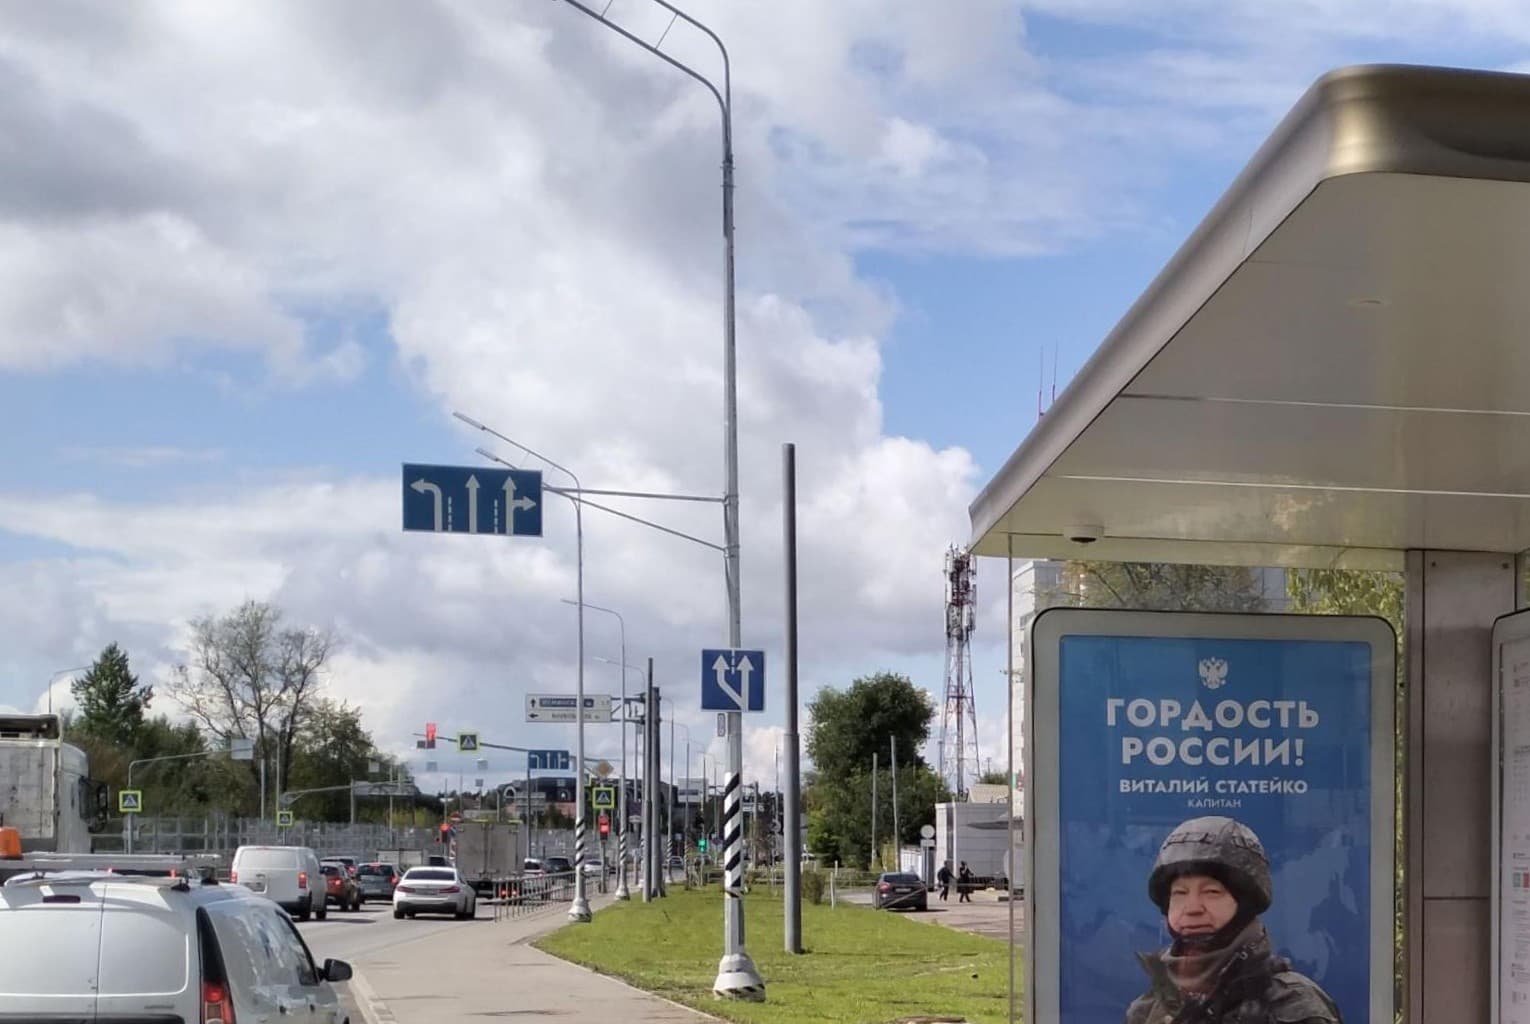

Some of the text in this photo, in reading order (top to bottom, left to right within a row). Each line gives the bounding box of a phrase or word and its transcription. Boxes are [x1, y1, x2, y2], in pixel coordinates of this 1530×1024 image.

[1106, 698, 1320, 732] ГОРДОСТЬ
[1121, 736, 1305, 767] РОССИИ!
[1119, 776, 1308, 794] ВИТАЛИЙ СТАТЕЙКО
[1187, 799, 1242, 809] КАПИТАН
